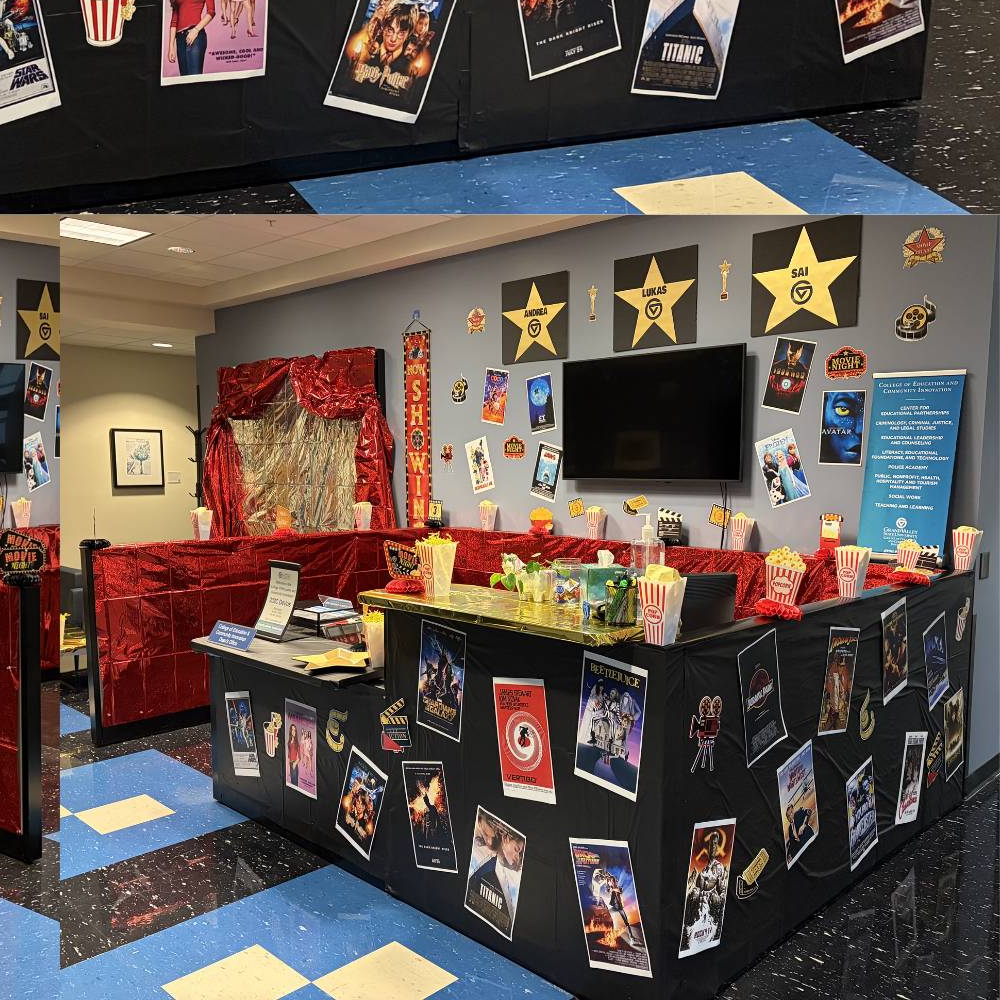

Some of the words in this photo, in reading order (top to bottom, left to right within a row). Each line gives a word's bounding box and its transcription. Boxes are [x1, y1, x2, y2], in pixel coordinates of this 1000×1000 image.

[536, 38, 547, 46] THE
[548, 34, 564, 42] DARK
[661, 42, 705, 65] TITANIC
[13, 63, 41, 78] STAR
[9, 71, 49, 91] WARS
[792, 267, 808, 279] SAI
[642, 285, 667, 298] LUKAS
[39, 312, 49, 321] SAI
[524, 307, 548, 319] ANDREA
[832, 356, 860, 365] MOVIE
[832, 361, 859, 371] NIGHT
[406, 364, 425, 376] NOW
[821, 427, 852, 435] AVATAR
[4, 551, 38, 563] MOVIE
[771, 580, 792, 589] POPCORN
[590, 662, 641, 689] BEETLEJUICE
[507, 774, 537, 784] VERTIGO
[480, 883, 503, 910] TITANIC
